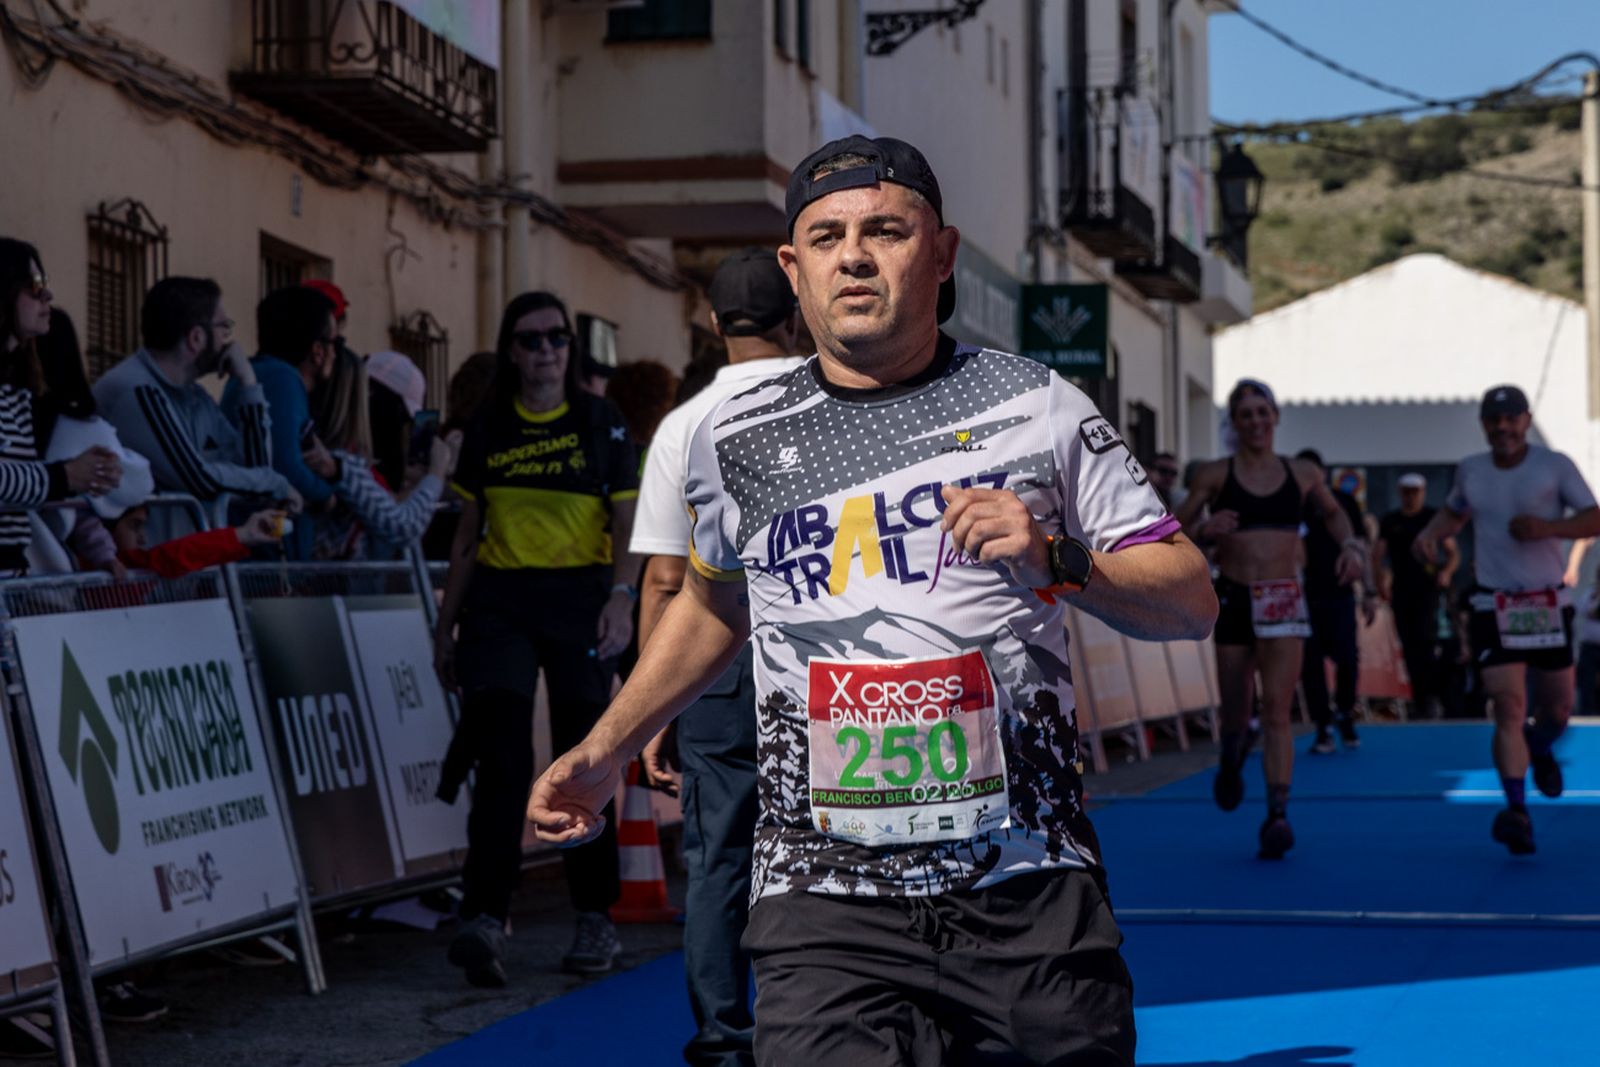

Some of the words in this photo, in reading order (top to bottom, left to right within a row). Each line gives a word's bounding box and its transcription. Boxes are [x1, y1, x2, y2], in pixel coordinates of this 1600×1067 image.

[772, 534, 930, 606] TRAIL
[829, 671, 854, 705] X
[860, 675, 963, 707] CROSS
[829, 703, 943, 729] PANTANO
[107, 658, 253, 796] TECNOCASA
[277, 693, 368, 796] UNED
[835, 720, 968, 788] 250
[141, 805, 217, 847] FRANCHISING
[217, 794, 270, 828] NETWORK
[812, 788, 882, 805] FRANCISCO
